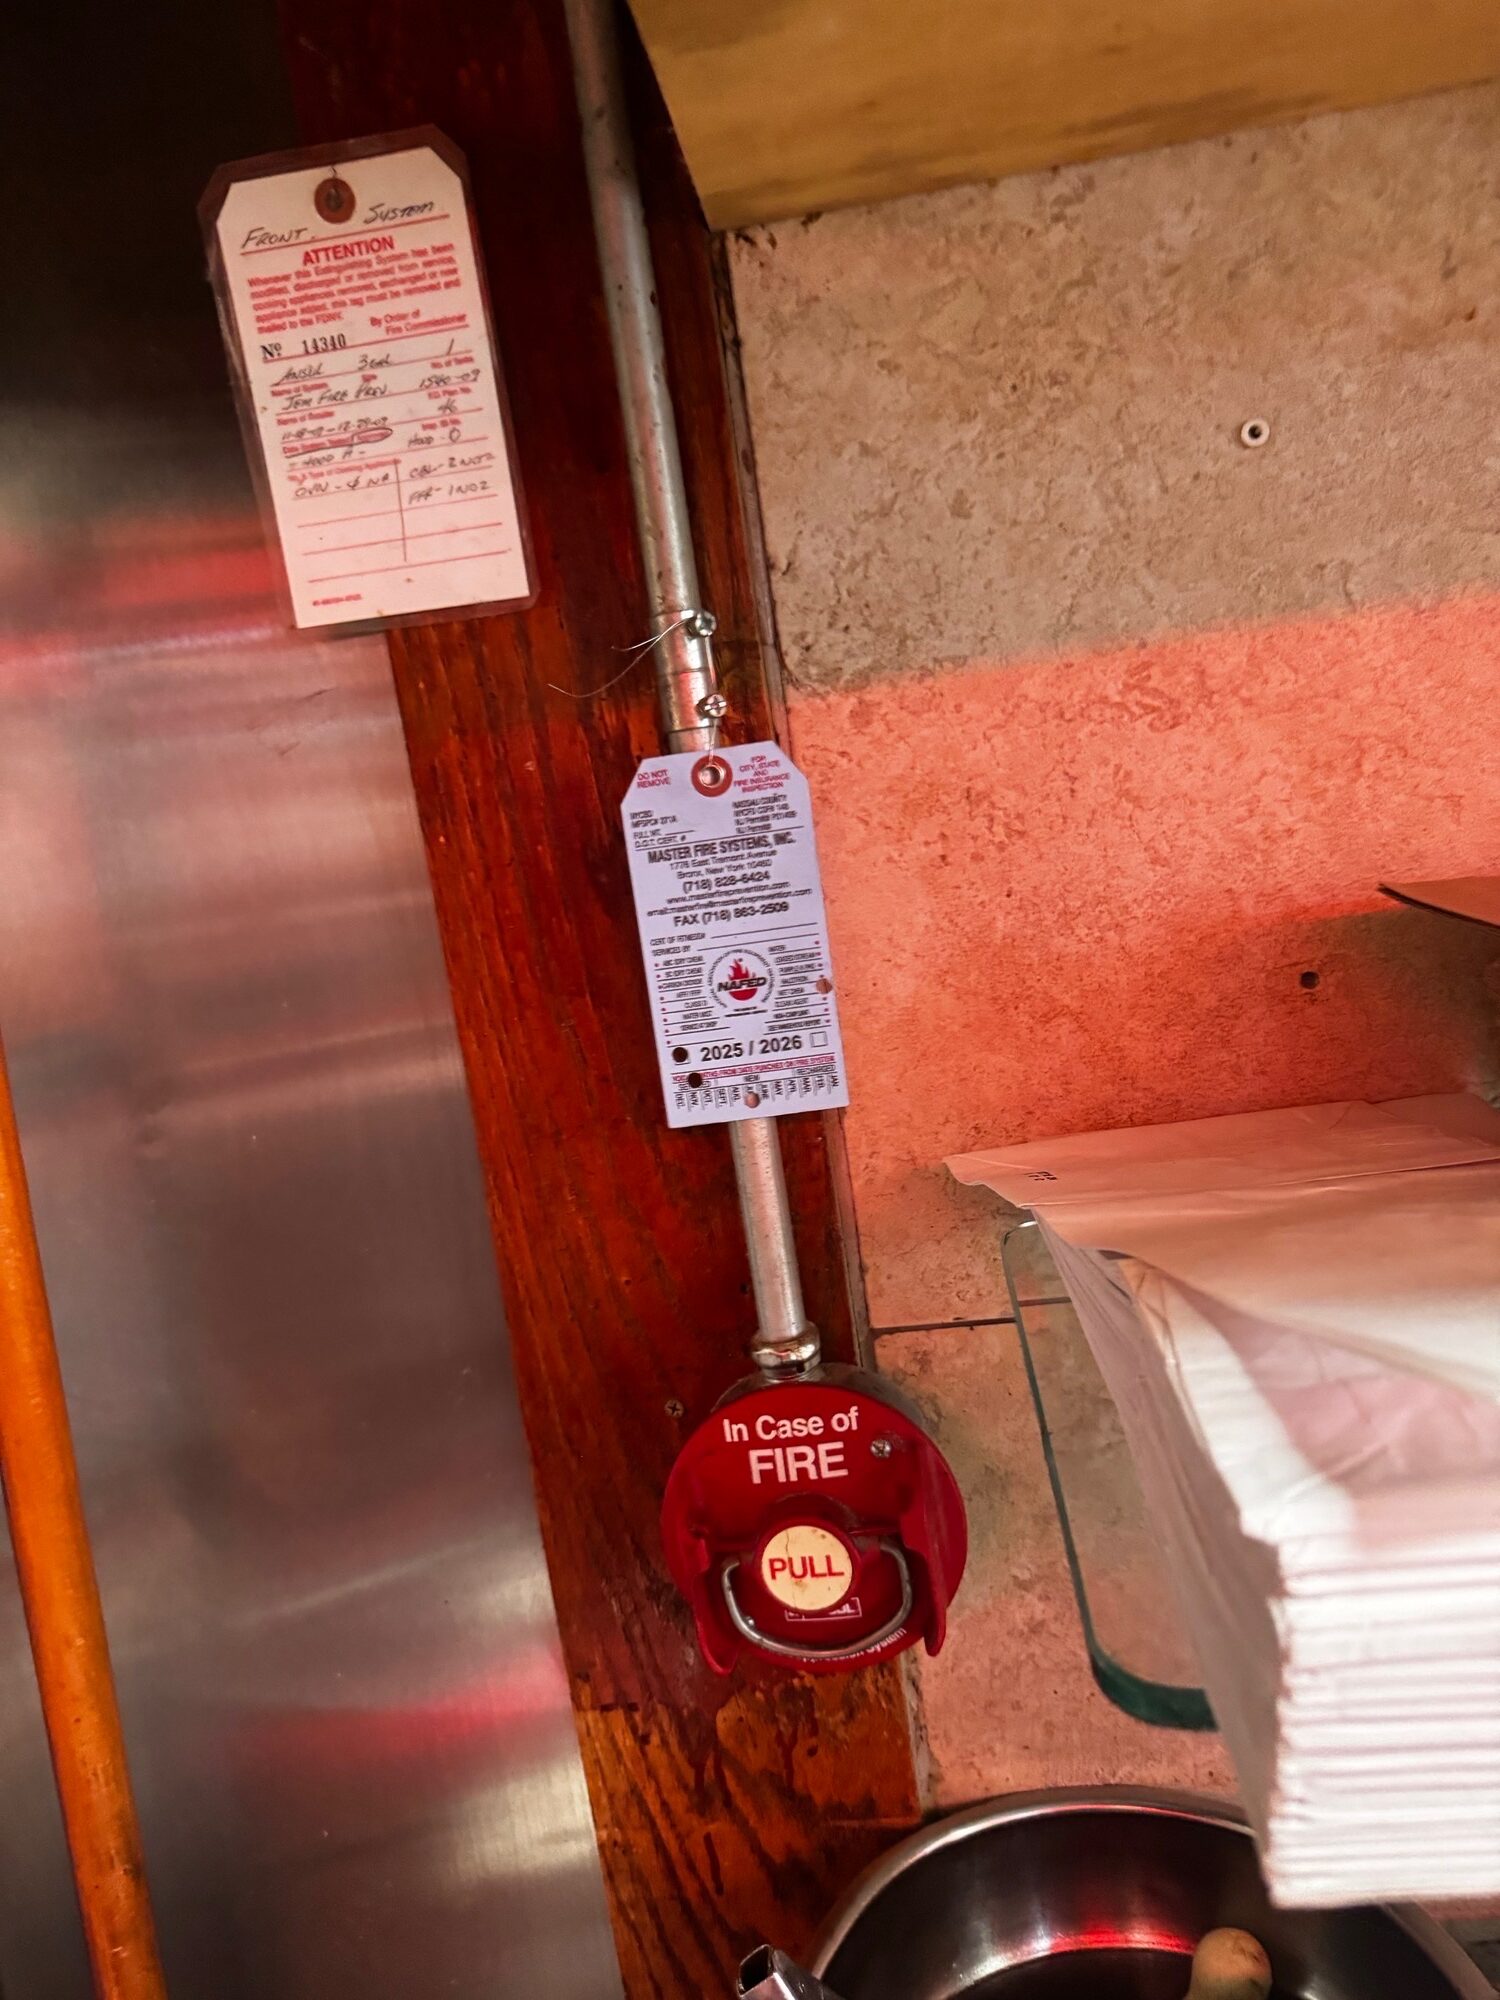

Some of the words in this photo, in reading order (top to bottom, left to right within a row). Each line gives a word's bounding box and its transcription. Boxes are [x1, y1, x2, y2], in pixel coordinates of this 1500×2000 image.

[303, 235, 395, 266] ATTENTION
[375, 251, 409, 265] System
[302, 333, 347, 355] 14340
[637, 772, 650, 781] DO
[651, 769, 669, 779] NOT
[734, 779, 748, 787] FIRE
[749, 772, 791, 784] INSURANCE
[753, 769, 769, 777] AND
[637, 777, 671, 789] REMOVE
[741, 781, 784, 793] INSPECTION
[647, 846, 692, 864] MASTER
[693, 842, 718, 857] FIRE
[719, 835, 772, 854] SYSTEMS,
[773, 831, 797, 846] INC.
[746, 849, 778, 859] Avenue
[705, 867, 724, 876] New
[726, 863, 745, 872] York
[683, 878, 712, 894] (718)
[673, 913, 700, 927] FAX
[702, 909, 732, 925] (718)
[717, 976, 767, 992] NAFED
[700, 1042, 744, 1062] 2025
[748, 1040, 754, 1056] /
[759, 1034, 803, 1054] 2026
[723, 1418, 749, 1443] In
[755, 1414, 824, 1440] Case
[830, 1405, 859, 1432] of
[748, 1440, 849, 1485] FIRE
[768, 1554, 845, 1581] PULL
